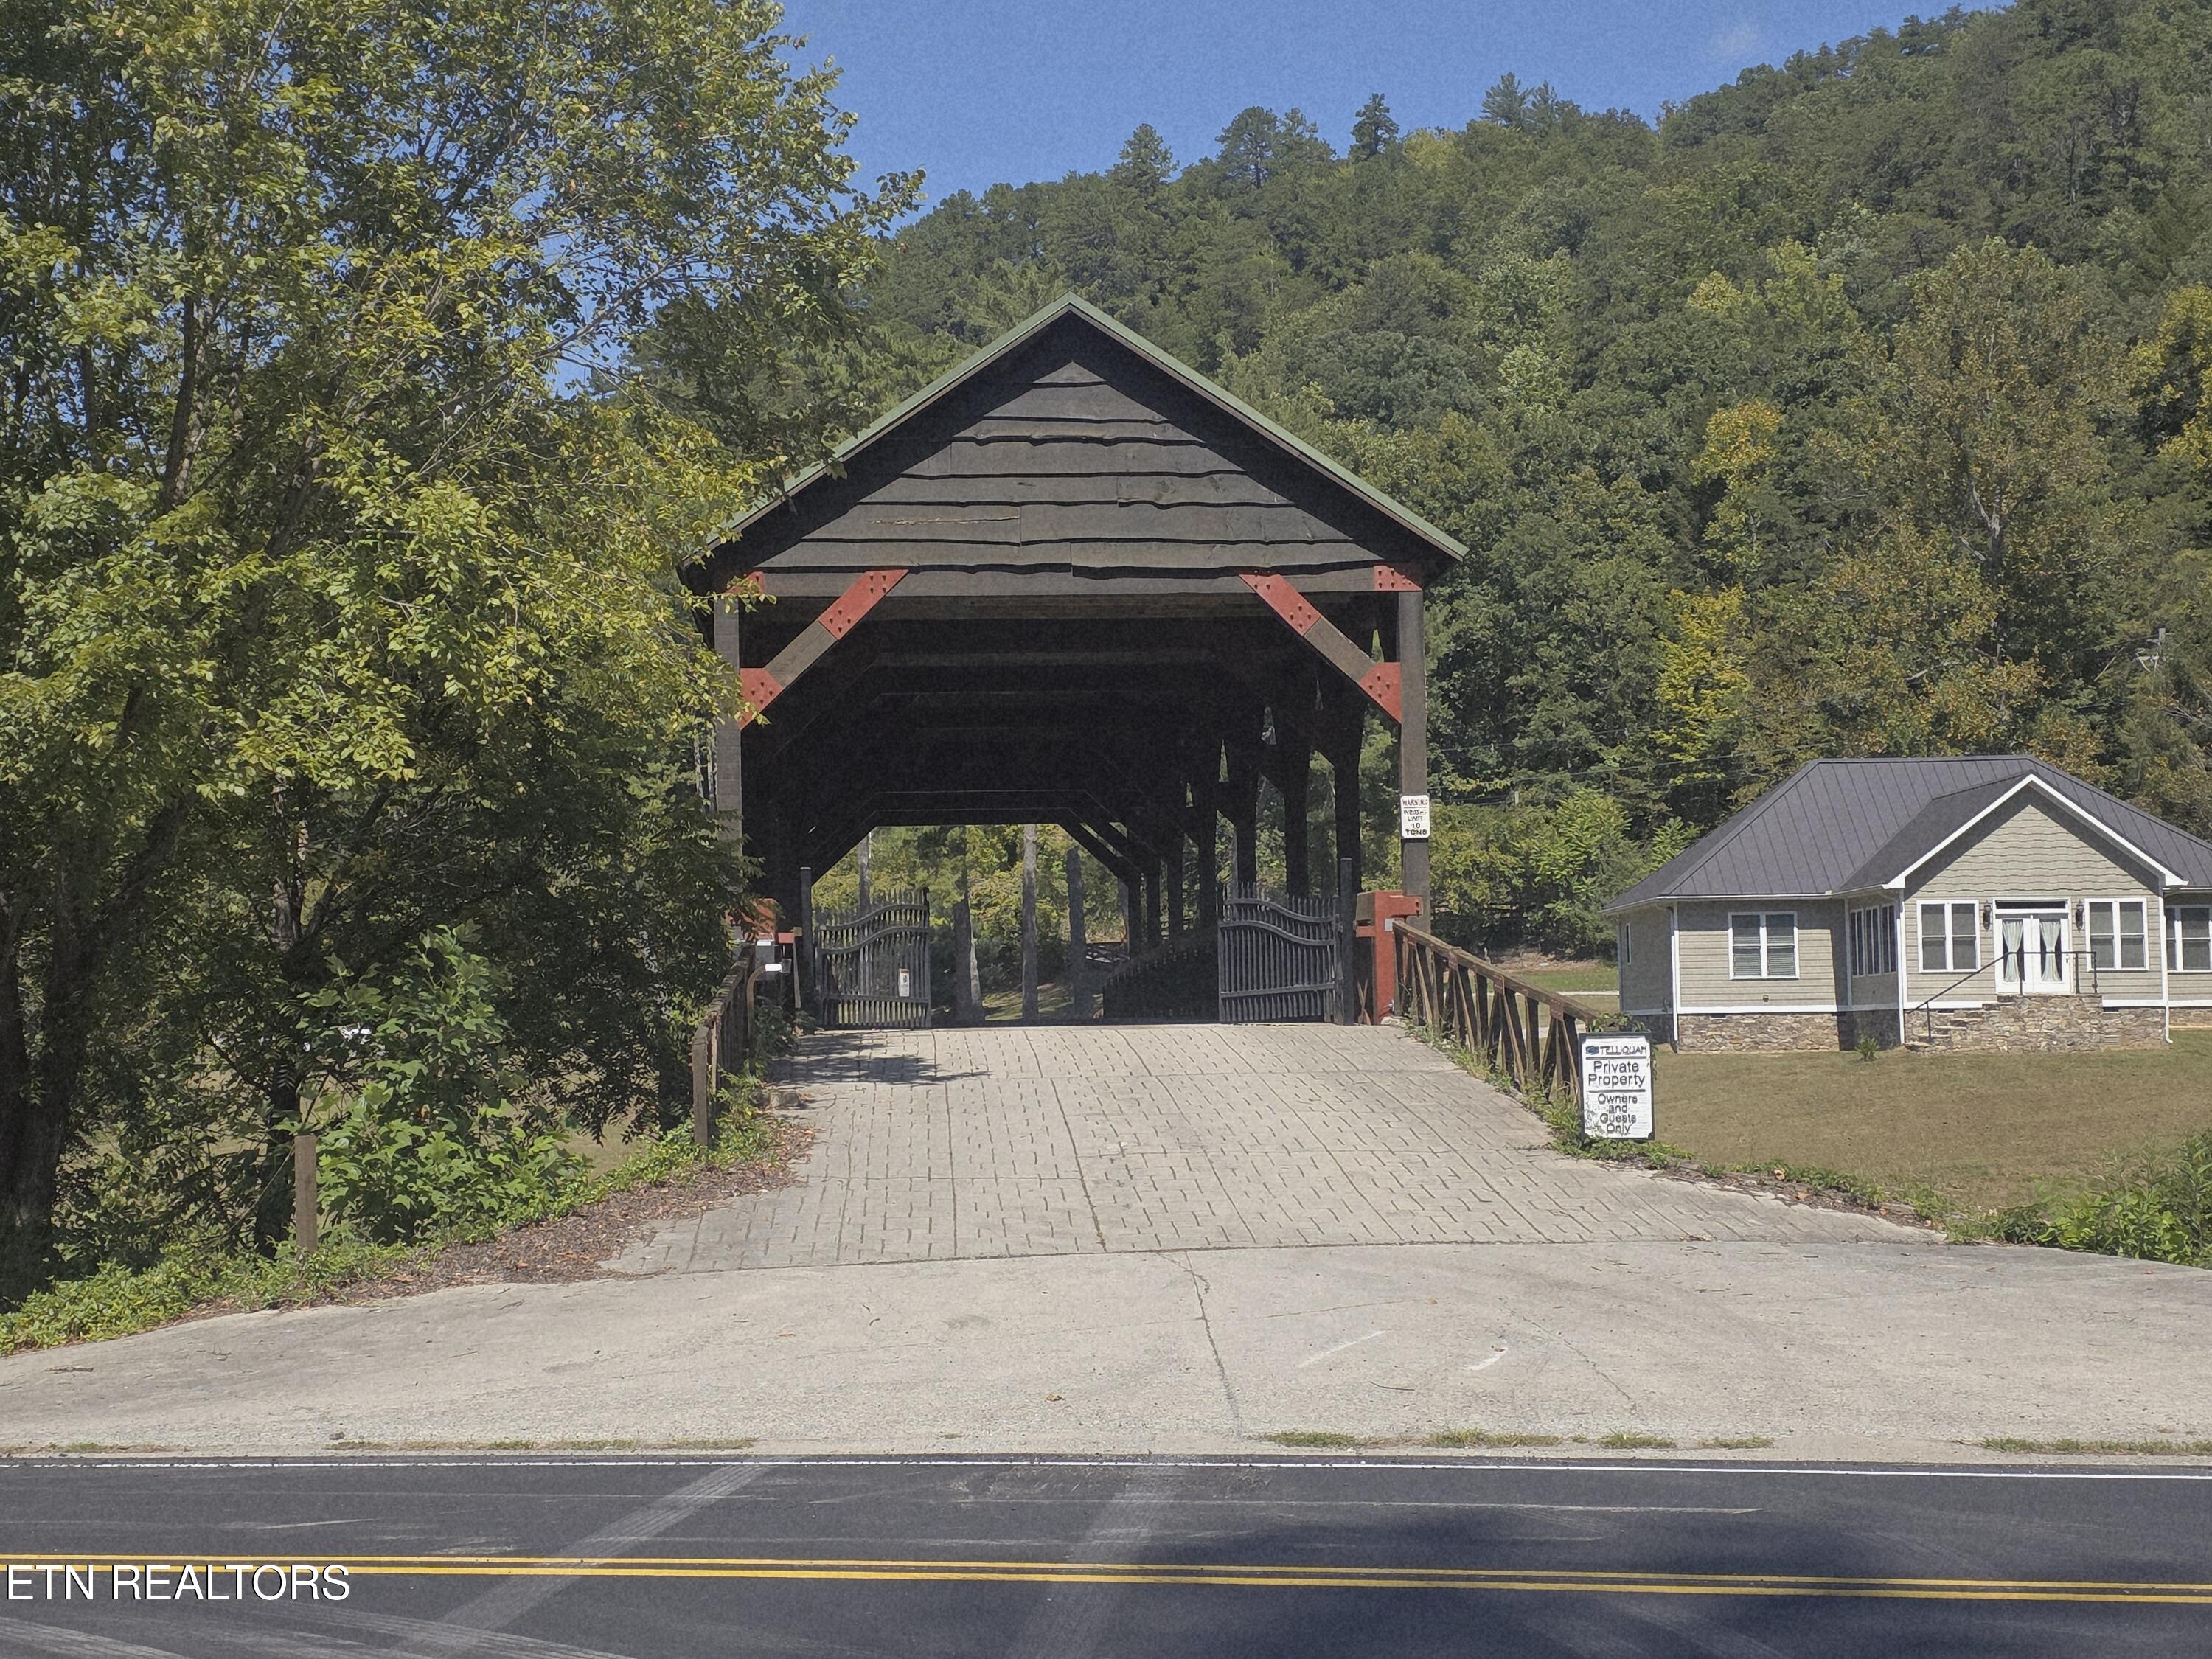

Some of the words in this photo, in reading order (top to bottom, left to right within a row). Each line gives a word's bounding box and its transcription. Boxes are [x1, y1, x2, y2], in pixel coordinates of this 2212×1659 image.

[1593, 1060, 1639, 1074] Private
[1589, 1074, 1645, 1088] Property
[1598, 1093, 1638, 1105] Owners
[1609, 1104, 1627, 1113] and
[1600, 1113, 1636, 1124] Guests
[1607, 1123, 1632, 1135] Only
